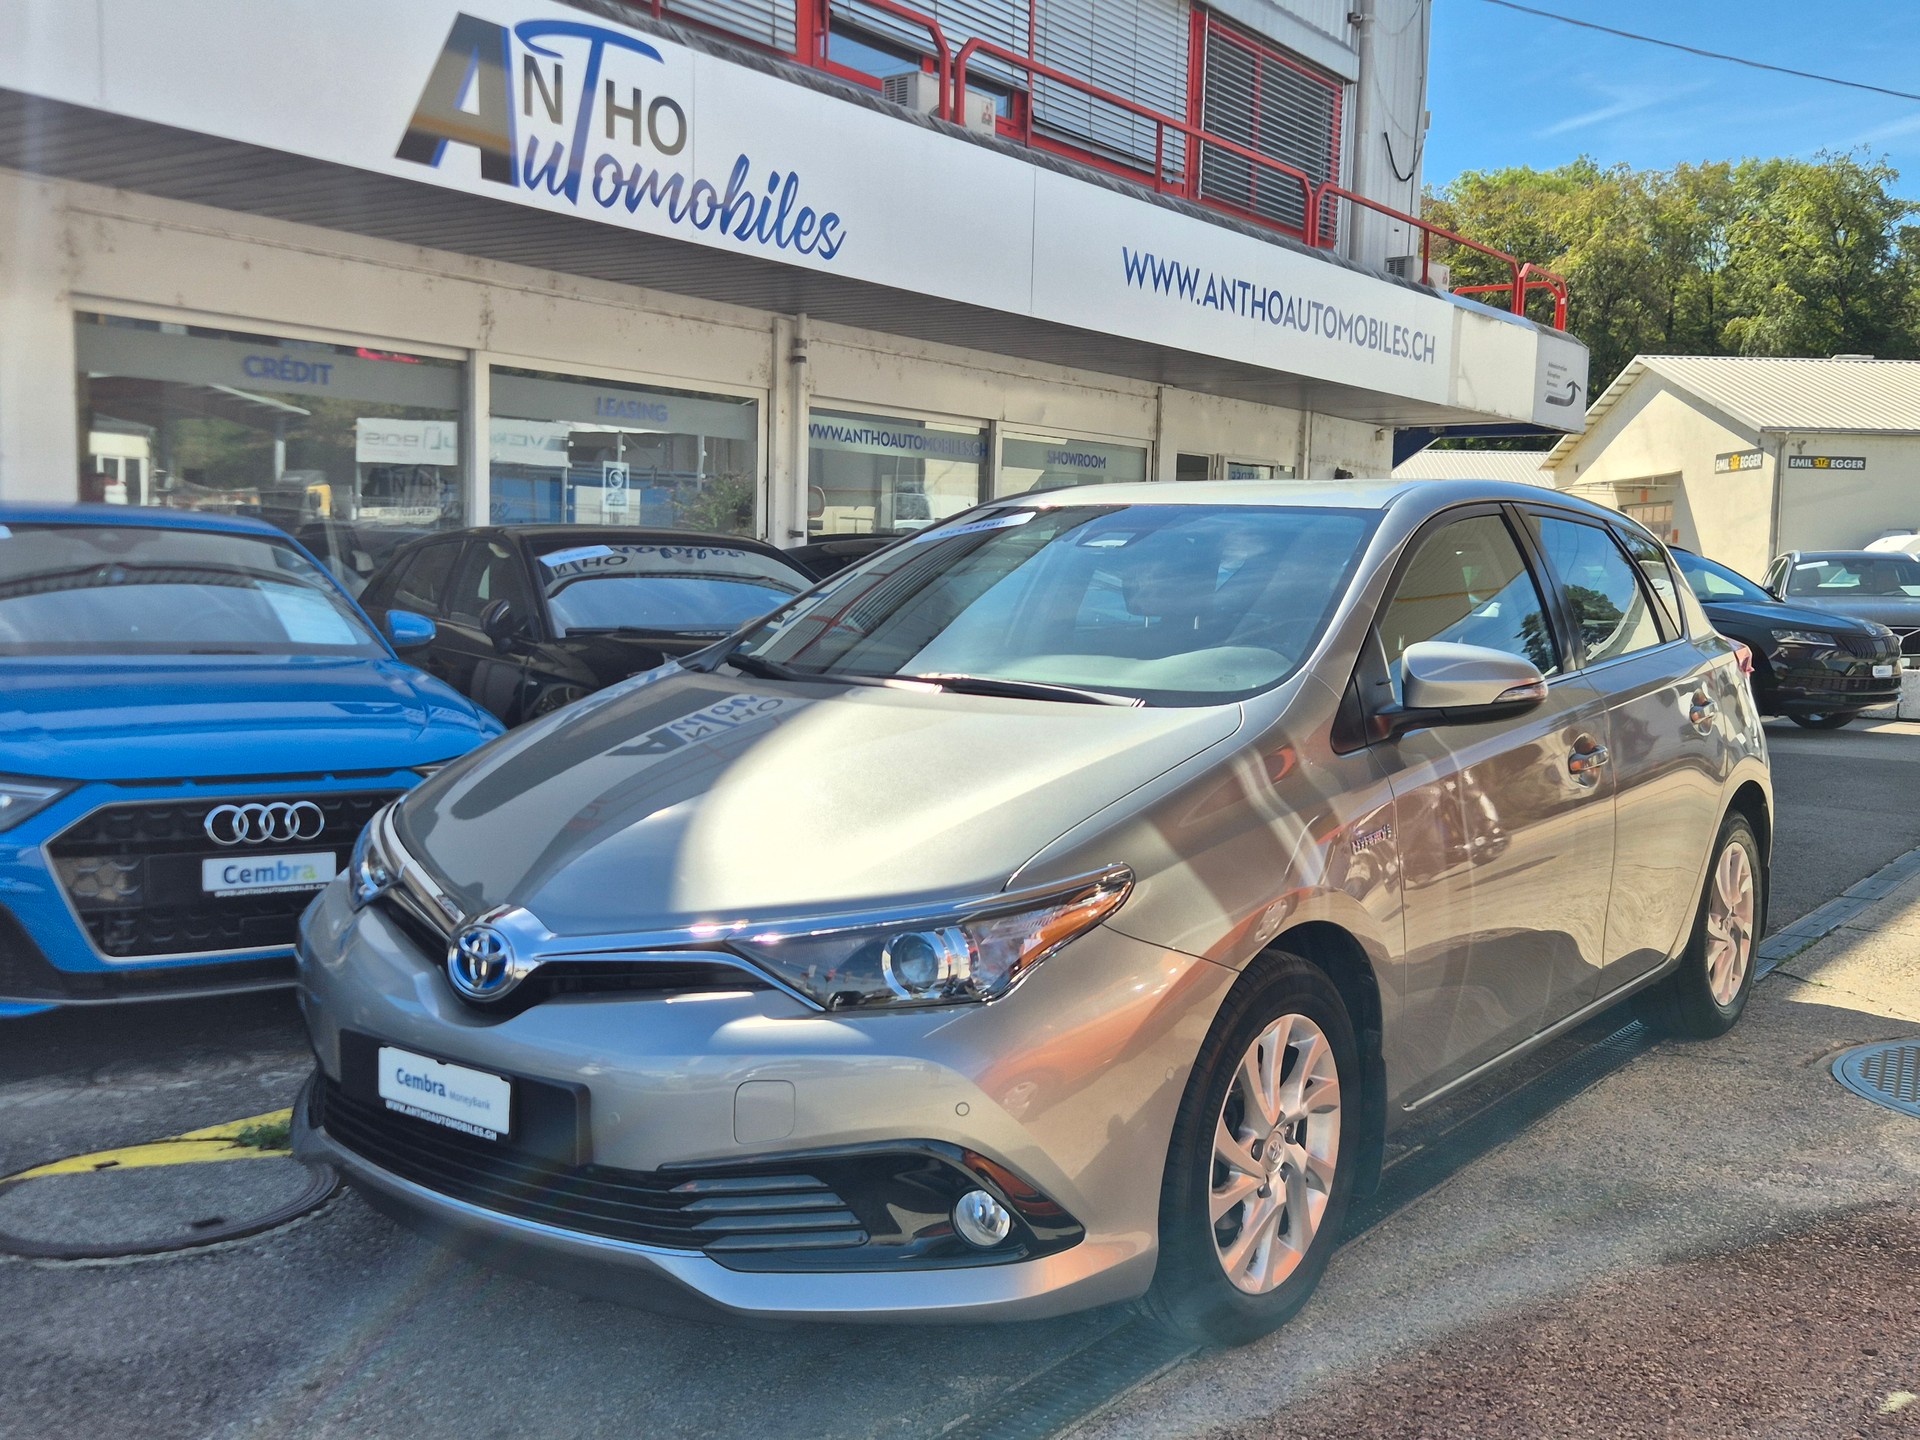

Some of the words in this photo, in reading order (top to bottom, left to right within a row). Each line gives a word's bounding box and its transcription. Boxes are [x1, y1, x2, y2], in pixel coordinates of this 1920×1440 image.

[395, 11, 687, 206] ANTHO
[1122, 246, 1436, 364] WWW.ANTHOAUTOMOBILES.CH
[243, 354, 333, 386] CRÉDIT
[597, 396, 669, 423] LEASING
[1046, 450, 1107, 470] SHOWROOM
[1715, 458, 1730, 471] EMIL
[1740, 453, 1762, 468] EGGER
[1790, 458, 1813, 468] EMIL
[1830, 458, 1864, 469] EGGER
[223, 860, 317, 884] Cembra
[396, 1067, 446, 1097] Cembra
